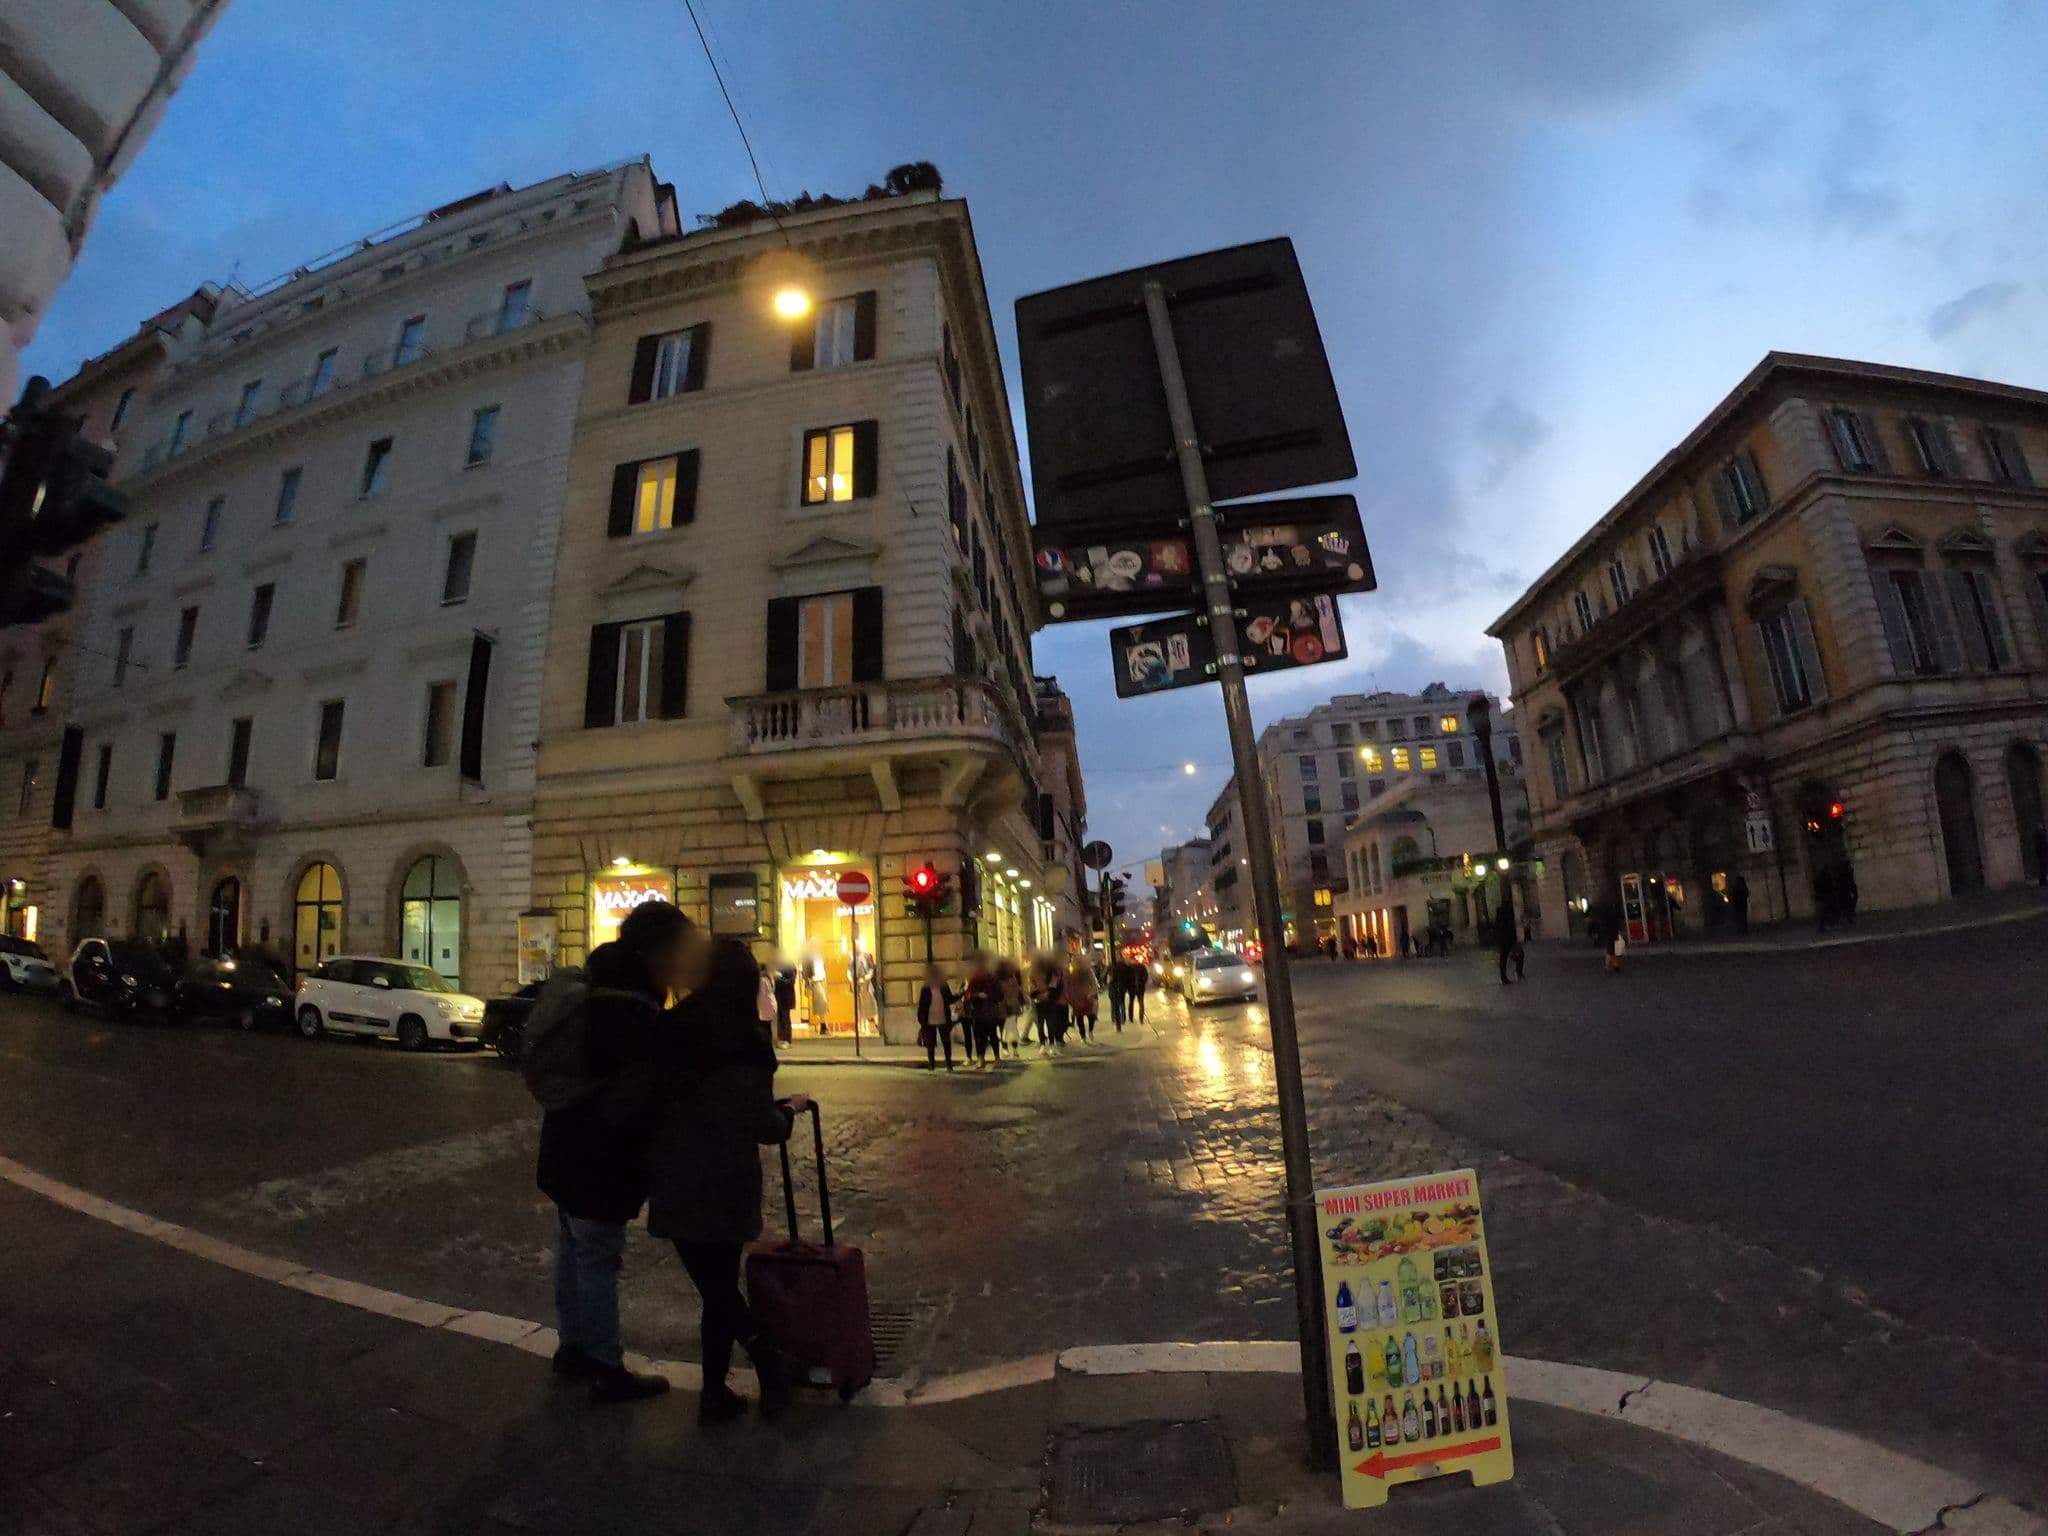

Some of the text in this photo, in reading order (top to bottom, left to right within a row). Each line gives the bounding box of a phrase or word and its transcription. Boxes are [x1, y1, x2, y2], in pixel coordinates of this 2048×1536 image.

[1324, 1178, 1471, 1216] MINI SUPER MARKET
